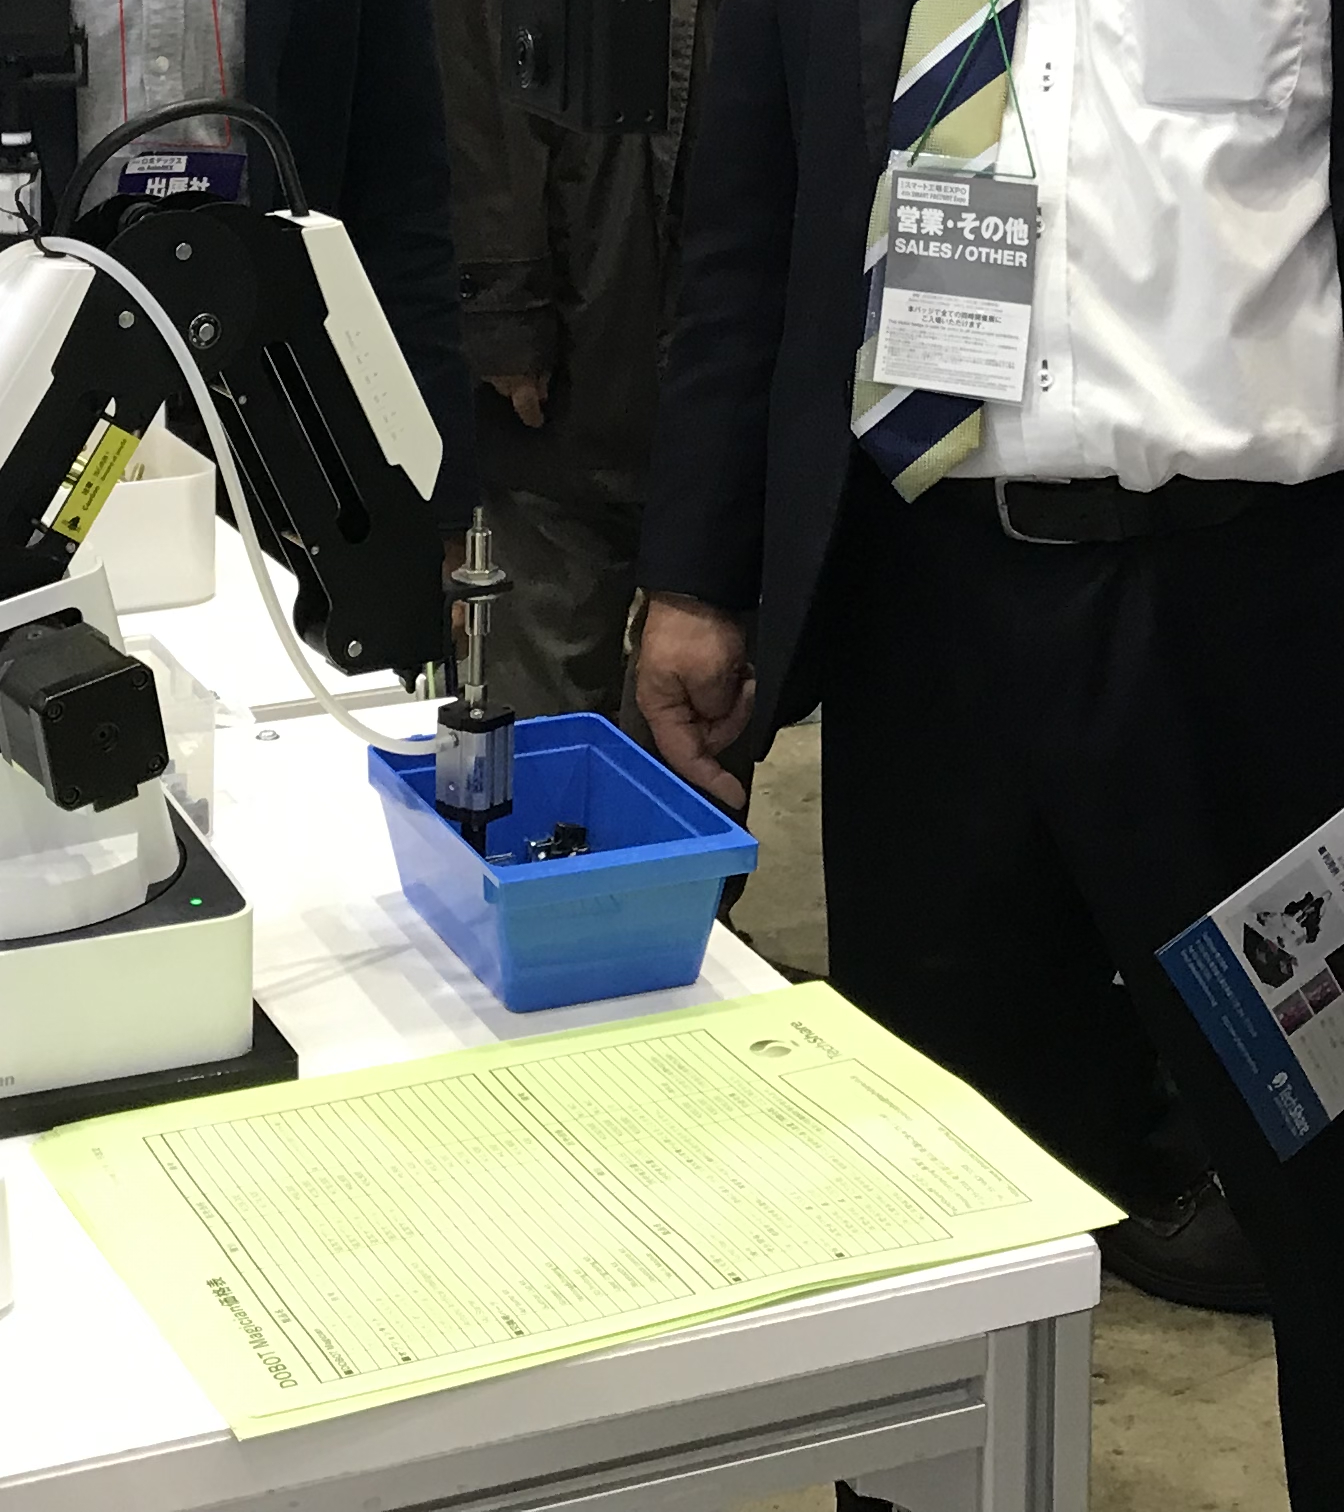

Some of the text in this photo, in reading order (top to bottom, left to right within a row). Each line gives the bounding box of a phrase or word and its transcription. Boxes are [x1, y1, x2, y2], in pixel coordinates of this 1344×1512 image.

[896, 204, 1030, 246] 営業・その他
[788, 1021, 842, 1060] TechShare
[204, 1276, 299, 1390] DOBOT Magician価格表
